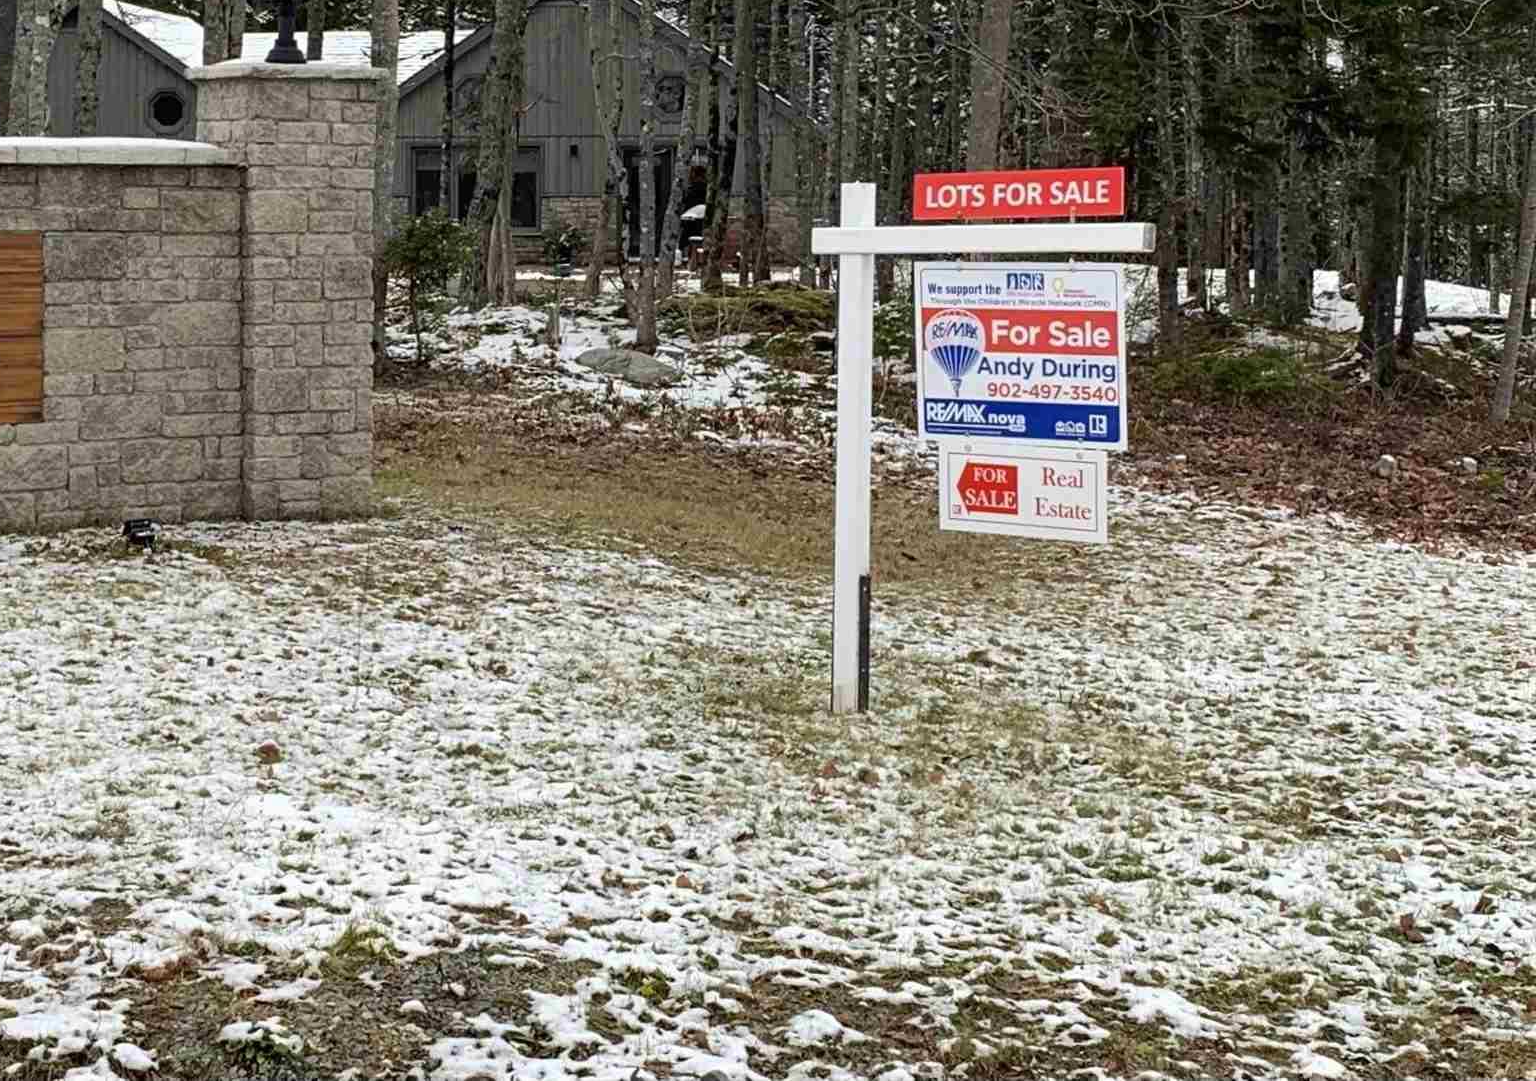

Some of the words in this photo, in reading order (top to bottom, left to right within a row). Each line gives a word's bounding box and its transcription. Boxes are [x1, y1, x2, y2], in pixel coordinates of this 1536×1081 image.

[925, 183, 985, 208] LOTS
[992, 182, 1042, 207] FOR
[1049, 180, 1110, 205] SALE
[928, 283, 943, 294] We
[945, 284, 982, 296] support
[985, 284, 1002, 294] the
[932, 320, 978, 340] RE/MAX
[991, 319, 1040, 346] For
[1048, 321, 1110, 347] Sale
[977, 357, 1034, 379] Andy
[1042, 359, 1115, 383] During
[987, 383, 1117, 402] 902-497-3540
[926, 402, 987, 423] RE/MAX
[988, 412, 1026, 425] nova
[974, 468, 1008, 483] FOR
[1041, 467, 1083, 488] Real
[965, 489, 1016, 509] SALE
[1034, 497, 1091, 520] Estate
